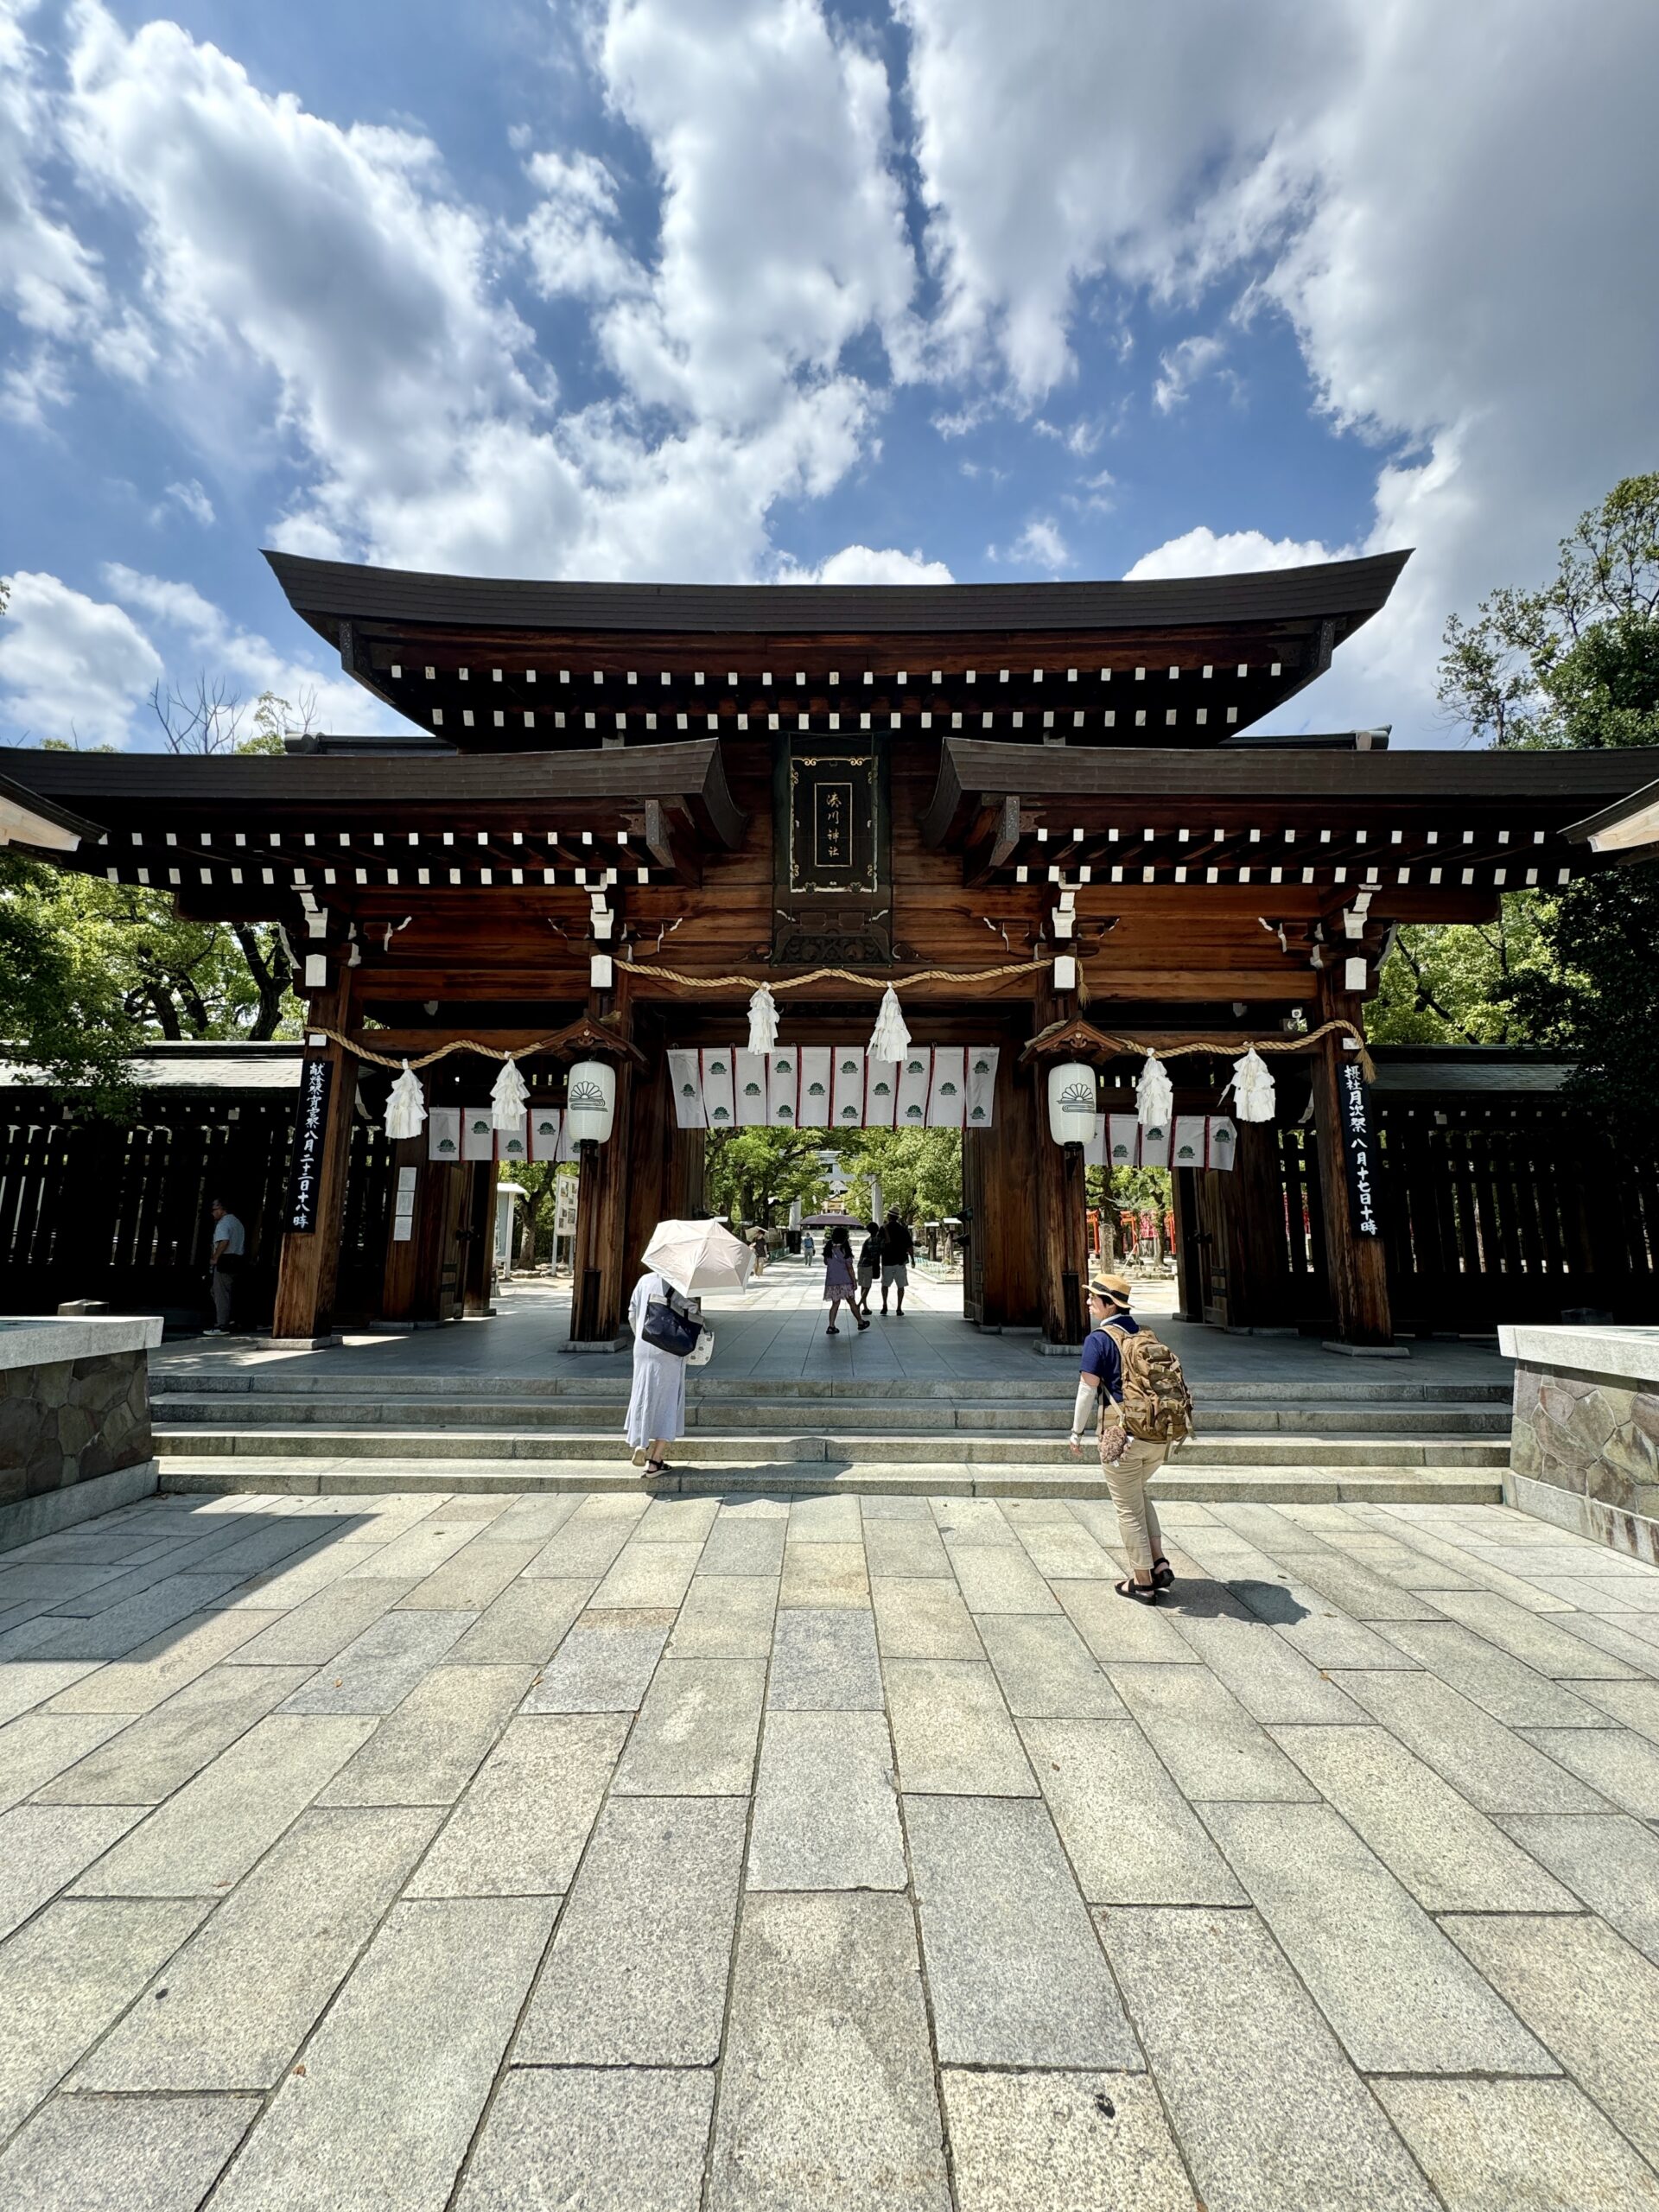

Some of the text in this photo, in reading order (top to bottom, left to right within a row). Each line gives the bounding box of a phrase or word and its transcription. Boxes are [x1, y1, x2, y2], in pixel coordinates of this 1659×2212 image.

[826, 791, 842, 857] 湊川神社
[1344, 1065, 1377, 1235] 摂社月次祭八月十七日十時
